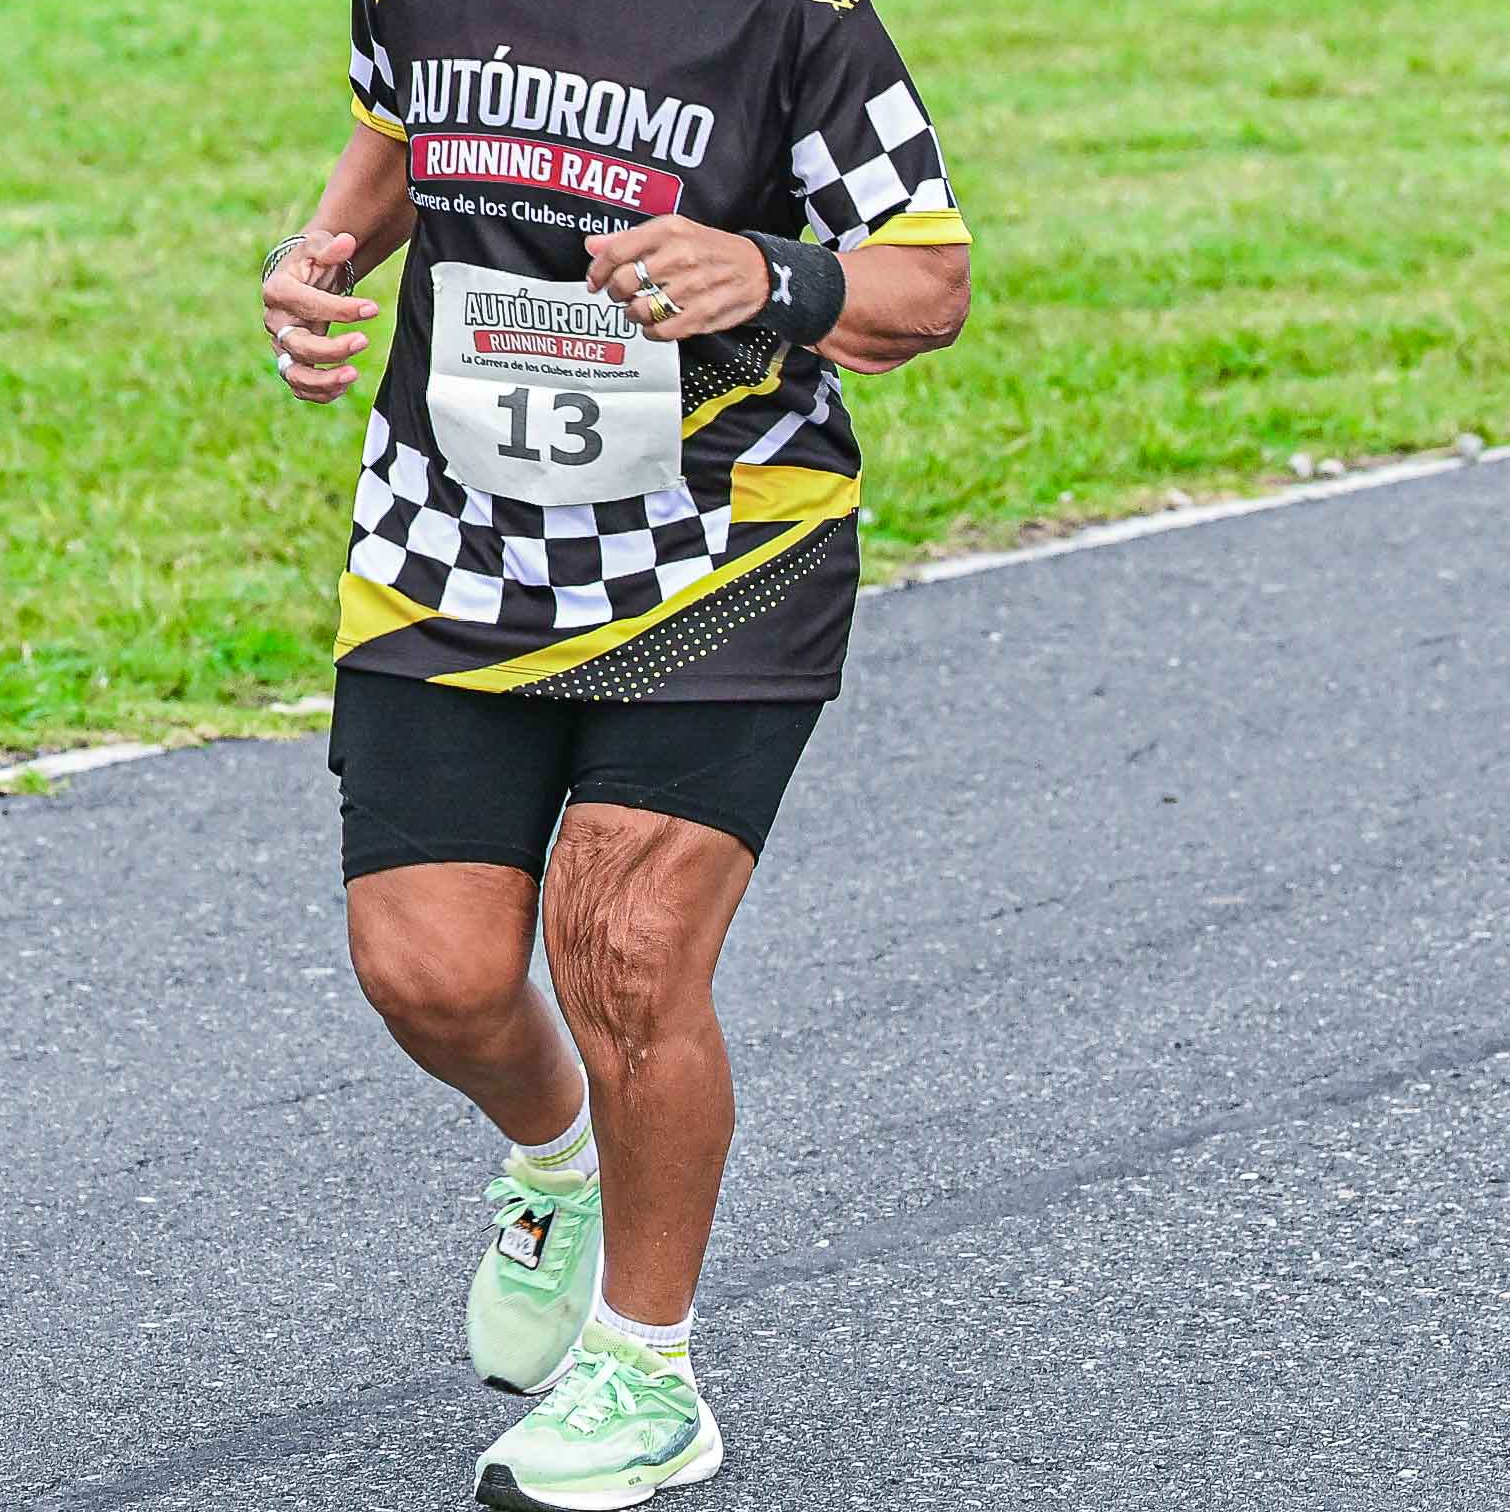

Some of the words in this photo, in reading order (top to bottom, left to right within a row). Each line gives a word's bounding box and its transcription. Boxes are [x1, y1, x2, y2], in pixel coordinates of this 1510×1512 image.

[406, 45, 715, 169] AUTÓDROMO
[425, 139, 553, 188] RUNNING
[559, 151, 649, 208] RACE
[453, 193, 476, 214] de
[479, 196, 507, 217] los
[511, 201, 575, 228] Clubes
[578, 212, 609, 234] del
[461, 353, 472, 364] La
[474, 355, 509, 369] Carrera
[511, 360, 523, 371] de
[525, 361, 540, 373] los
[540, 364, 573, 377] Clubes
[575, 368, 591, 378] del
[593, 368, 640, 379] Noroeste
[489, 333, 557, 355] RUNNING
[562, 340, 607, 361] RACE
[497, 387, 603, 466] 13
